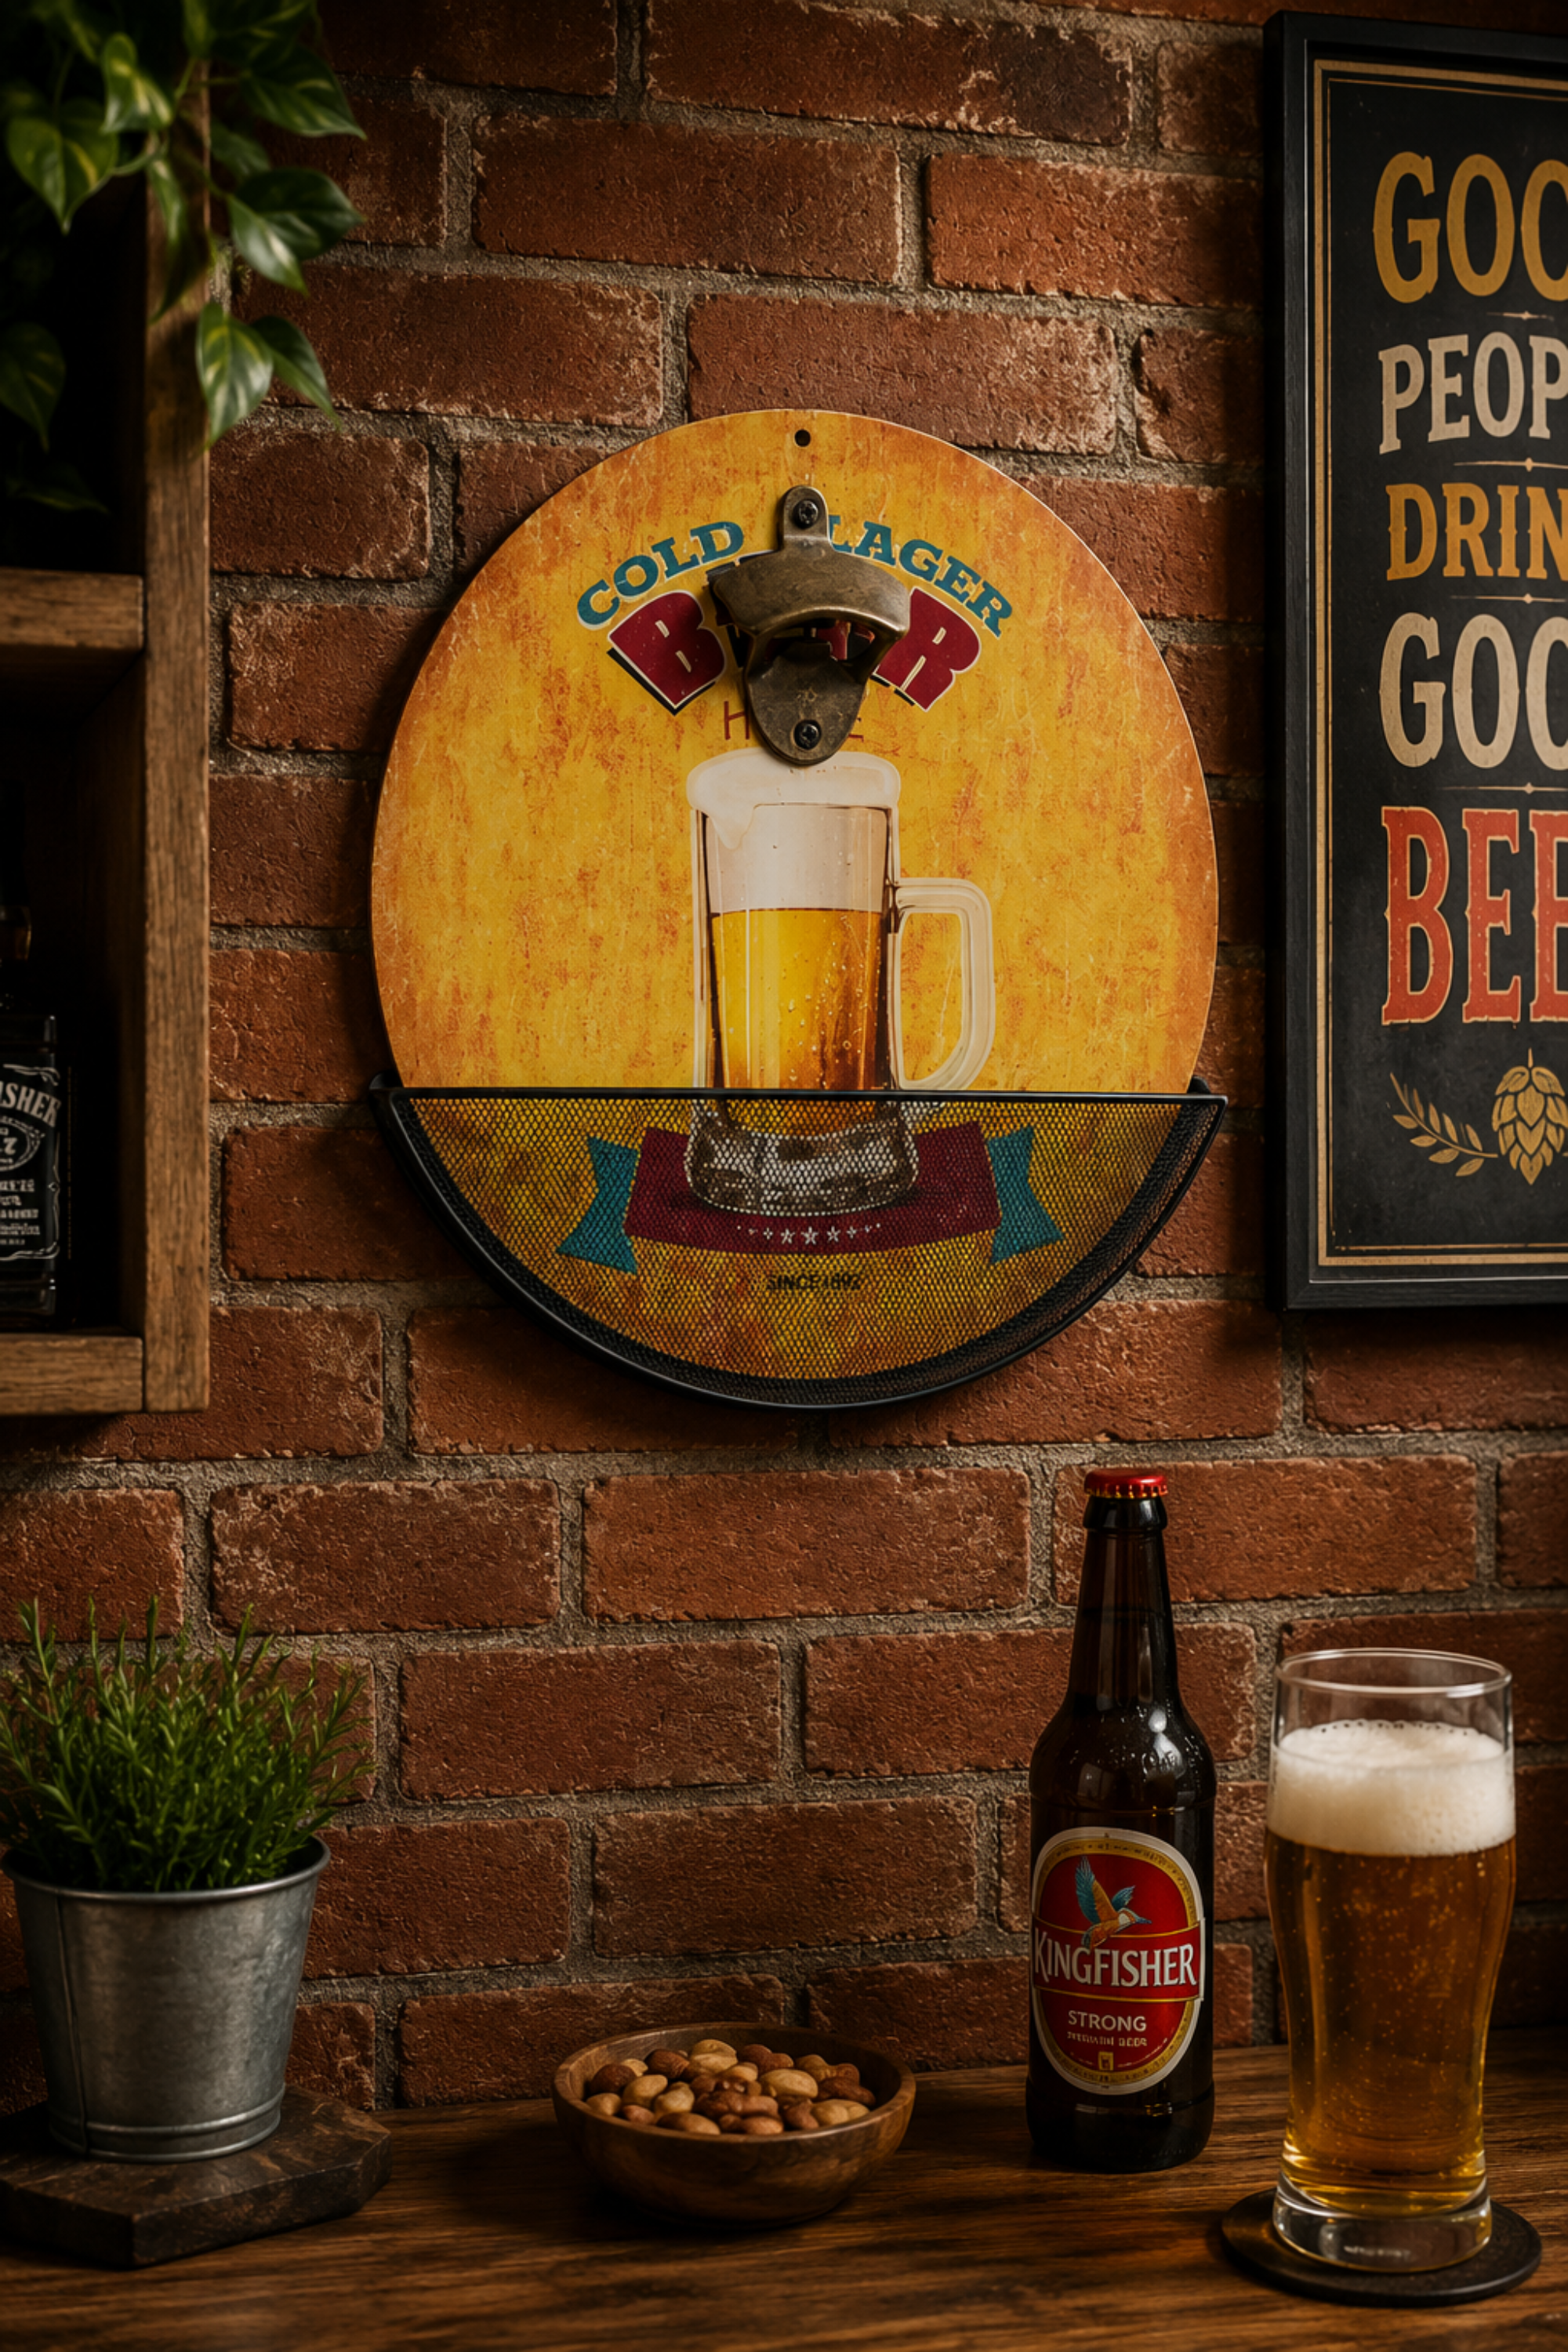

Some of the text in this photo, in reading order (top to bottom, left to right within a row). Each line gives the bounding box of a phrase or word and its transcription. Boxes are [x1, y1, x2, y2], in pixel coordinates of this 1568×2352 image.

[576, 521, 744, 629] COLD
[767, 1273, 821, 1290] SINCE
[1034, 1926, 1197, 1987] KINGFISHER
[1067, 2009, 1148, 2033] STRONG
